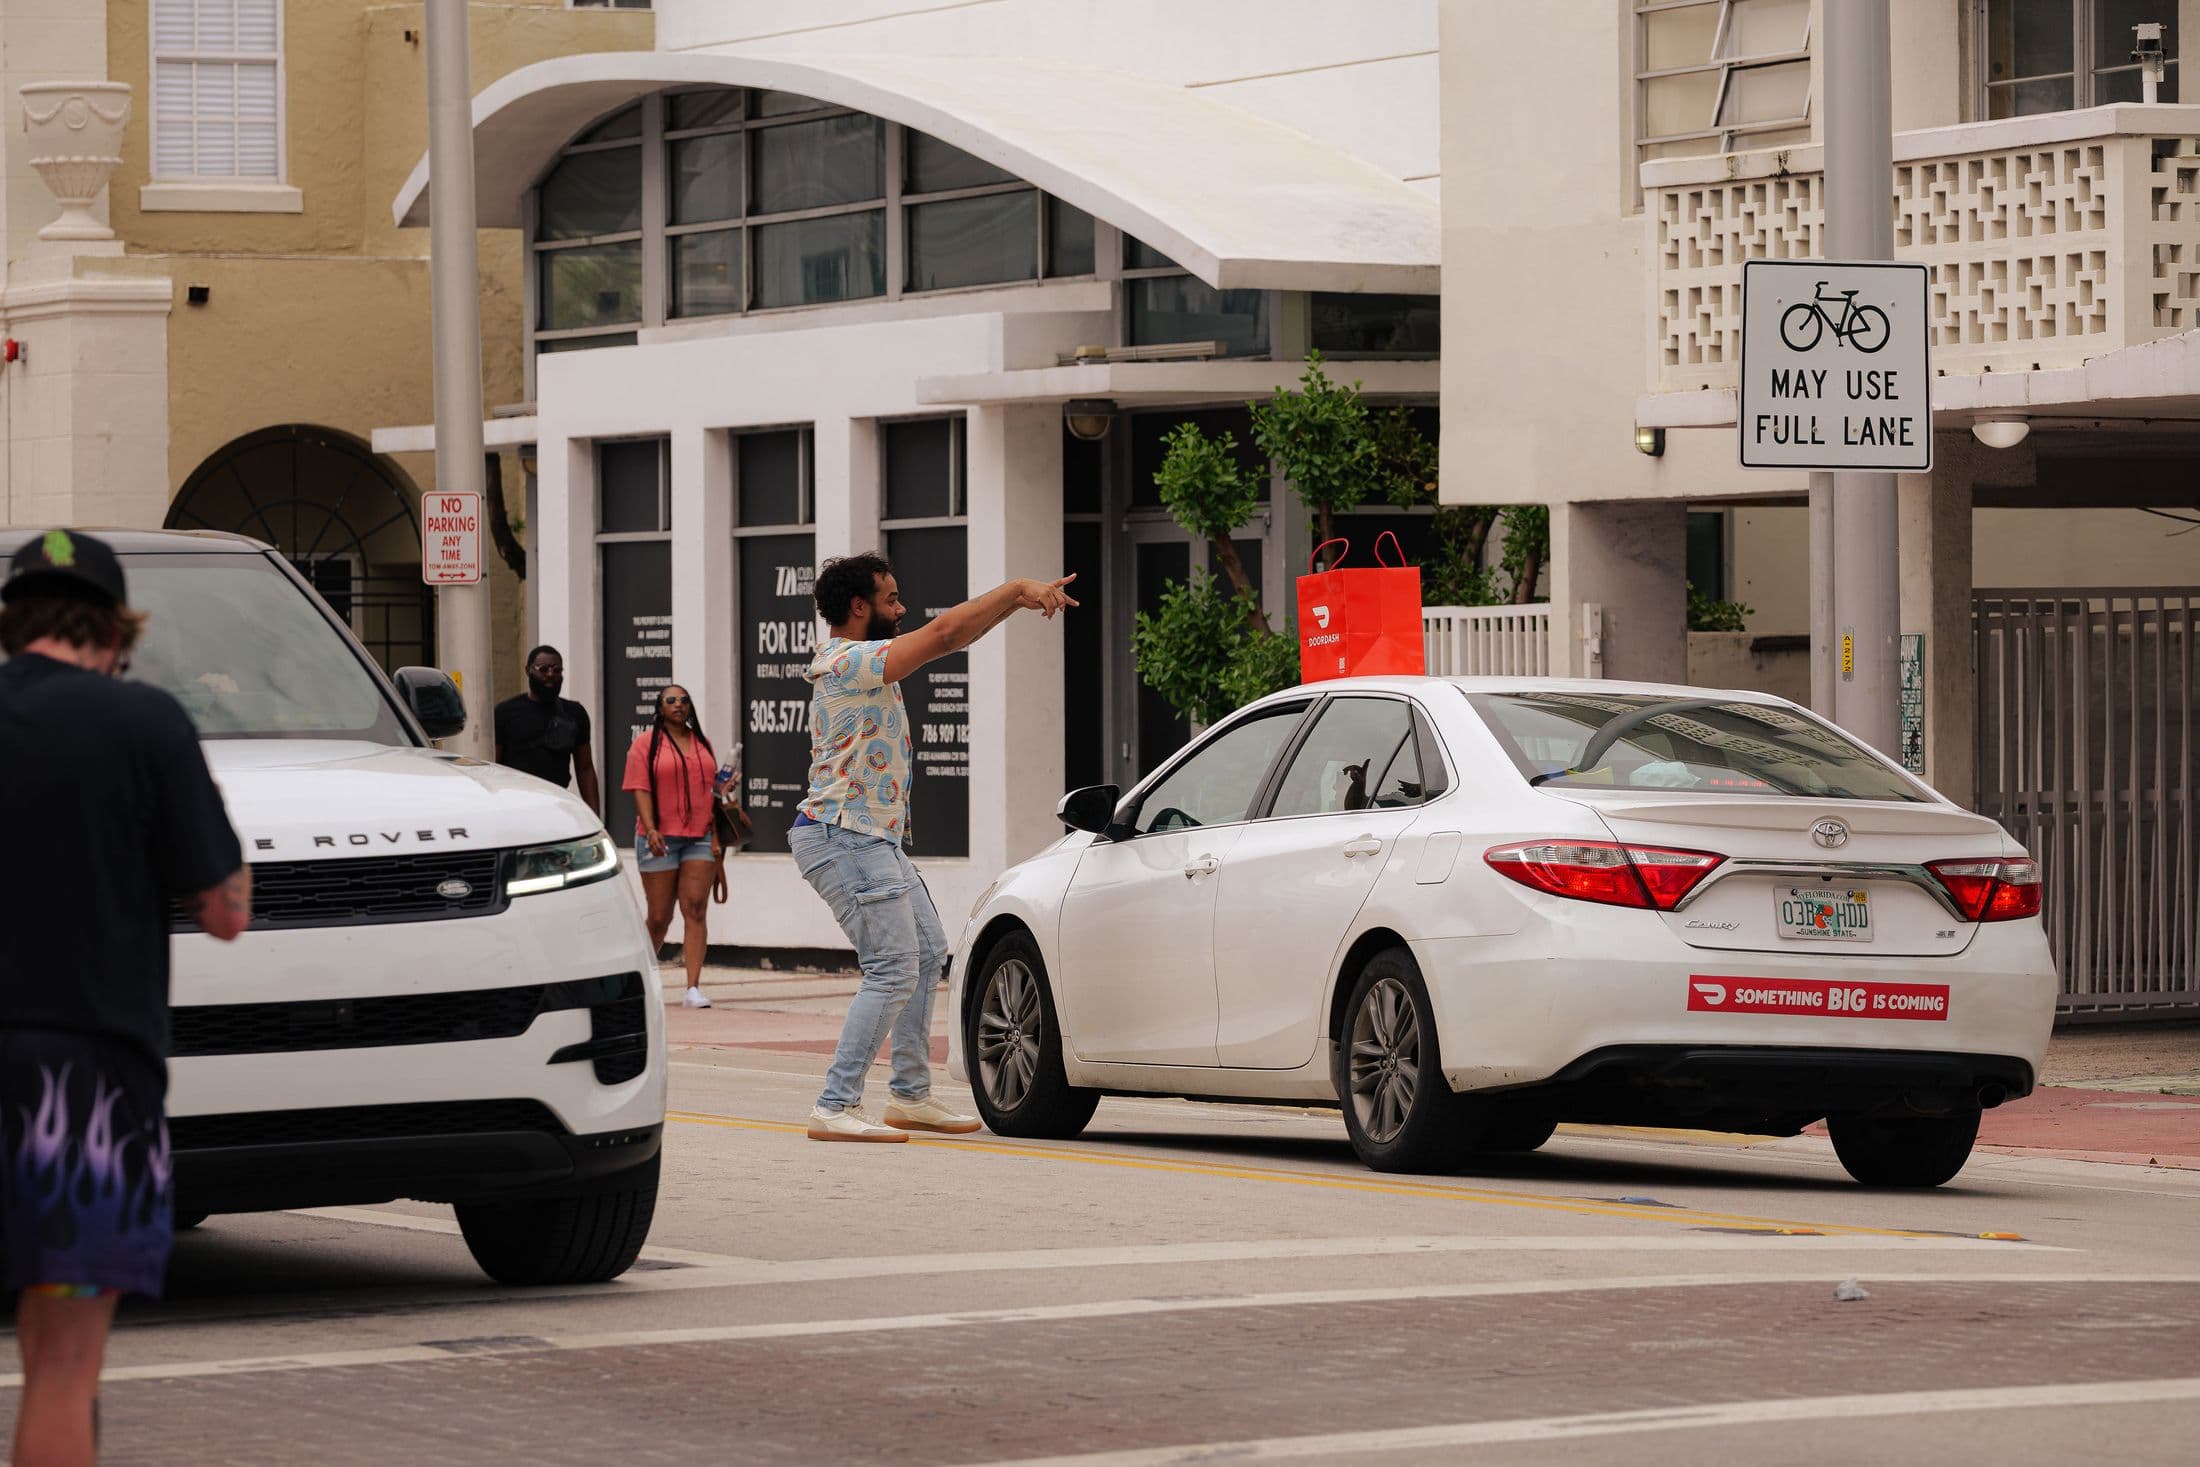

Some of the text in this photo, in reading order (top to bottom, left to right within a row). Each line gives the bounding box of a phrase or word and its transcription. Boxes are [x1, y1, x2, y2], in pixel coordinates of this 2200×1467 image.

[1772, 369, 1899, 400] MAY USE
[1756, 415, 1914, 447] FULL LANE
[441, 498, 462, 513] NO
[428, 517, 475, 532] PARKING
[442, 535, 461, 547] ANY
[441, 550, 461, 560] TIME
[758, 621, 787, 654] FOR
[1308, 633, 1340, 647] DOORDASH
[757, 664, 781, 678] RETAIL
[314, 828, 470, 847] ROVER
[1835, 902, 1869, 928] HDD
[1800, 928, 1853, 938] SUNSHINE STATE
[1734, 987, 1944, 1012] SOMETHING BIG IS COMING
